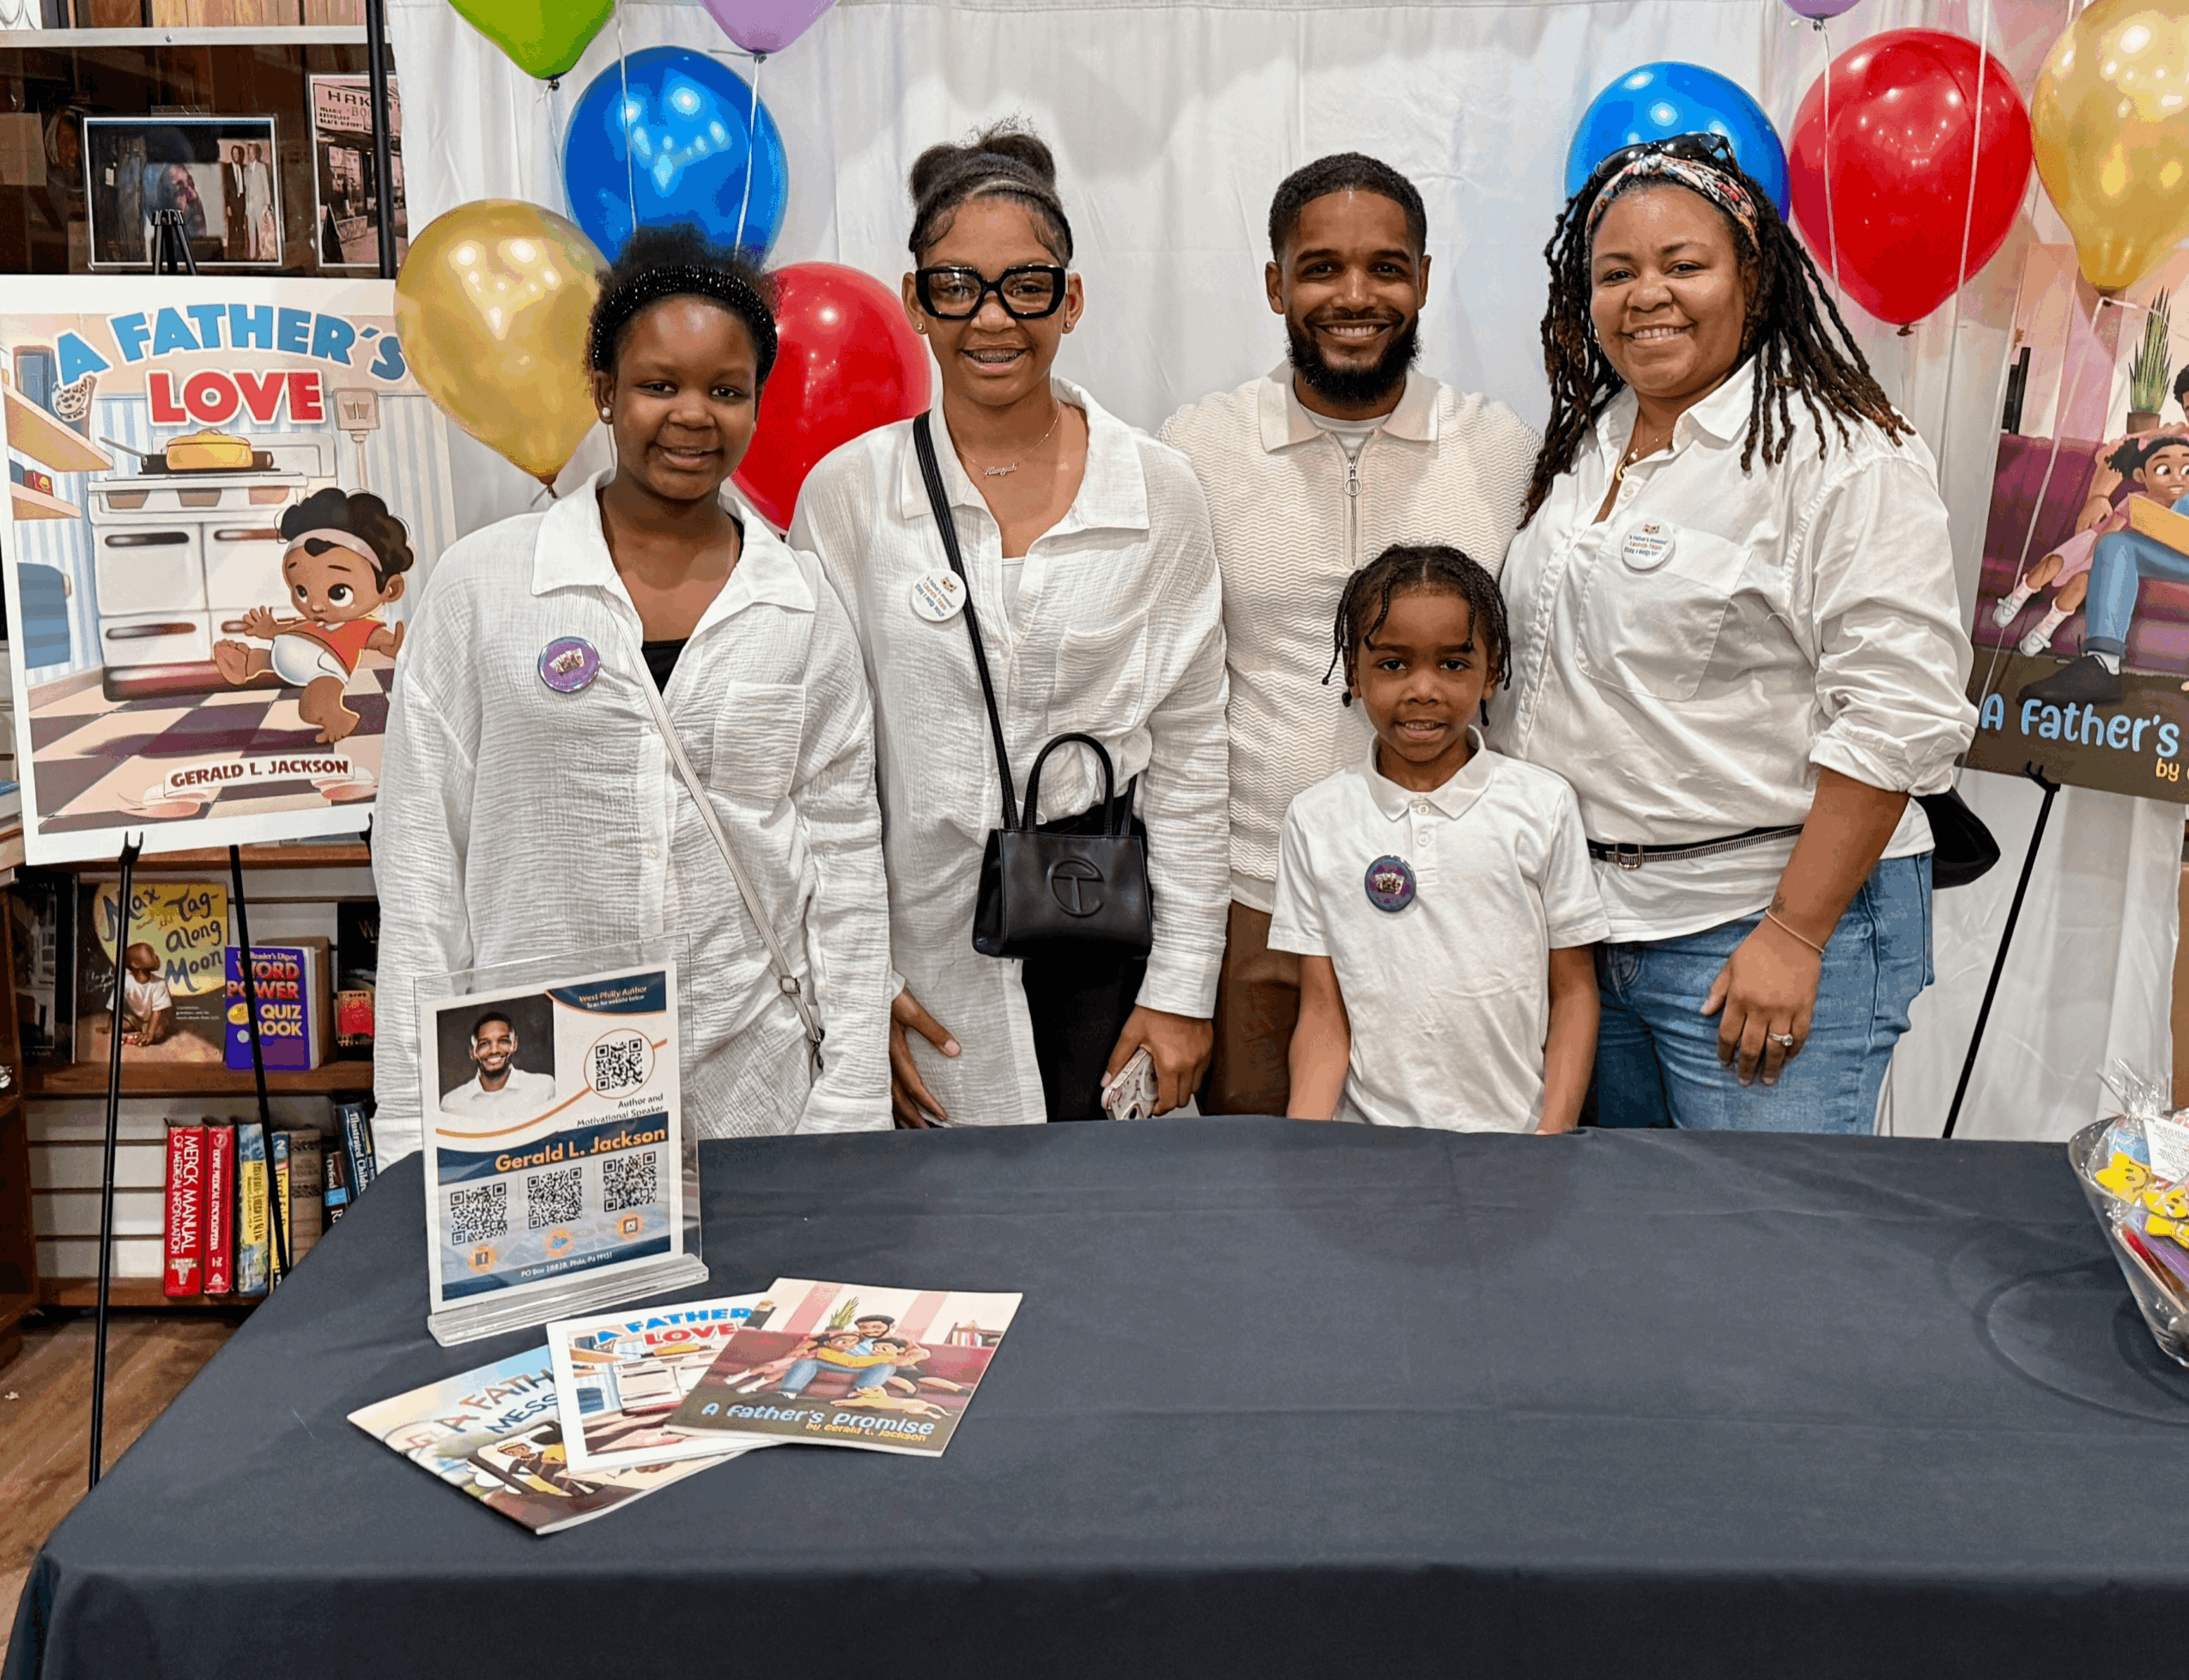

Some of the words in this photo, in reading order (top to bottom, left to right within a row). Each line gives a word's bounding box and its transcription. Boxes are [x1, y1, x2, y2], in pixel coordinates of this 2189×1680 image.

[58, 332, 111, 386] A
[110, 303, 406, 381] FATHER'S
[149, 371, 324, 423] LOVE
[1981, 693, 2004, 731] A
[2021, 698, 2180, 758] Father's
[170, 764, 245, 788] GERALD
[268, 760, 349, 775] JACKSON
[2156, 757, 2180, 782] by
[102, 889, 161, 942] Max
[164, 885, 219, 922] Tag-
[165, 950, 223, 992] Moon
[622, 986, 647, 996] Author
[260, 1004, 302, 1020] QUIZ
[617, 1098, 646, 1109] Author
[647, 1092, 664, 1104] and
[576, 1110, 629, 1128] Motivational
[630, 1106, 664, 1118] Speaker
[173, 1134, 184, 1149] OF
[495, 1143, 564, 1172] Gerald
[568, 1141, 586, 1158] L.
[589, 1129, 666, 1155] Jackson
[172, 1150, 183, 1190] MEDICAL
[182, 1135, 199, 1186] MERCK
[170, 1191, 183, 1254] INFORMATION
[180, 1188, 197, 1254] MANUAL
[520, 1269, 532, 1278] PO
[532, 1267, 545, 1276] Box
[597, 1330, 624, 1343] A
[644, 1322, 737, 1345] LOVE
[434, 1414, 481, 1433] A
[701, 1403, 720, 1416] A
[726, 1404, 826, 1425] Father's
[805, 1422, 822, 1431] by
[823, 1424, 863, 1434] Gerald
[864, 1428, 874, 1436] L.
[877, 1429, 927, 1442] Jackson
